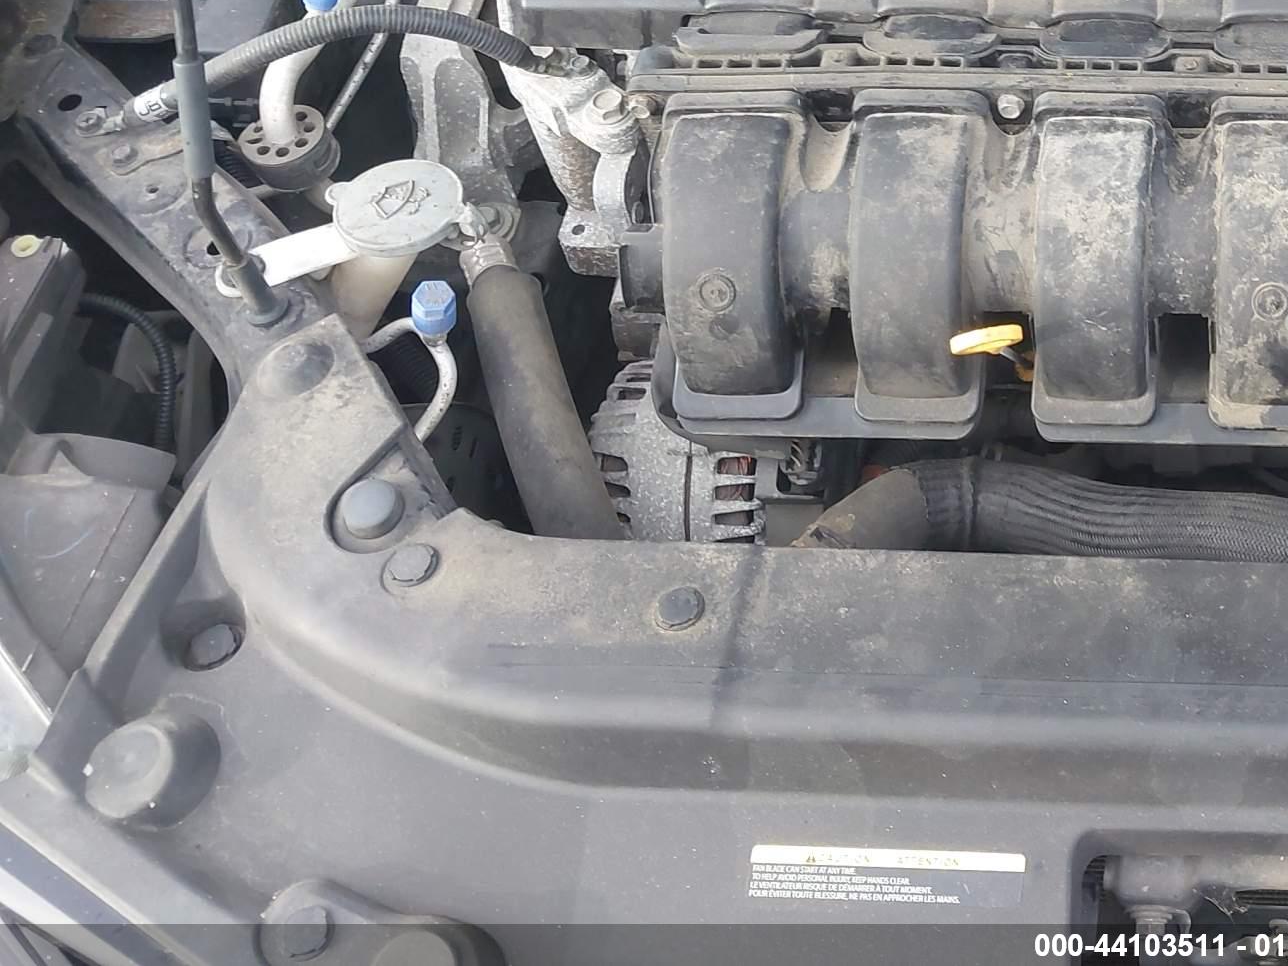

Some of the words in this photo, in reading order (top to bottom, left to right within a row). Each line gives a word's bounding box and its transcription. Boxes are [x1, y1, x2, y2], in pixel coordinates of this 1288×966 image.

[786, 865, 800, 873] CAN
[752, 872, 760, 880] TO
[797, 874, 828, 882] PERSONAL
[851, 876, 866, 884] KEEP
[867, 876, 889, 884] HANDS
[750, 881, 758, 889] LE
[882, 885, 899, 893] TOUT
[848, 892, 858, 900] NE
[859, 893, 872, 901] PAS
[873, 893, 882, 901] EN
[882, 894, 923, 903] APPROCHER
[924, 895, 936, 903] LES
